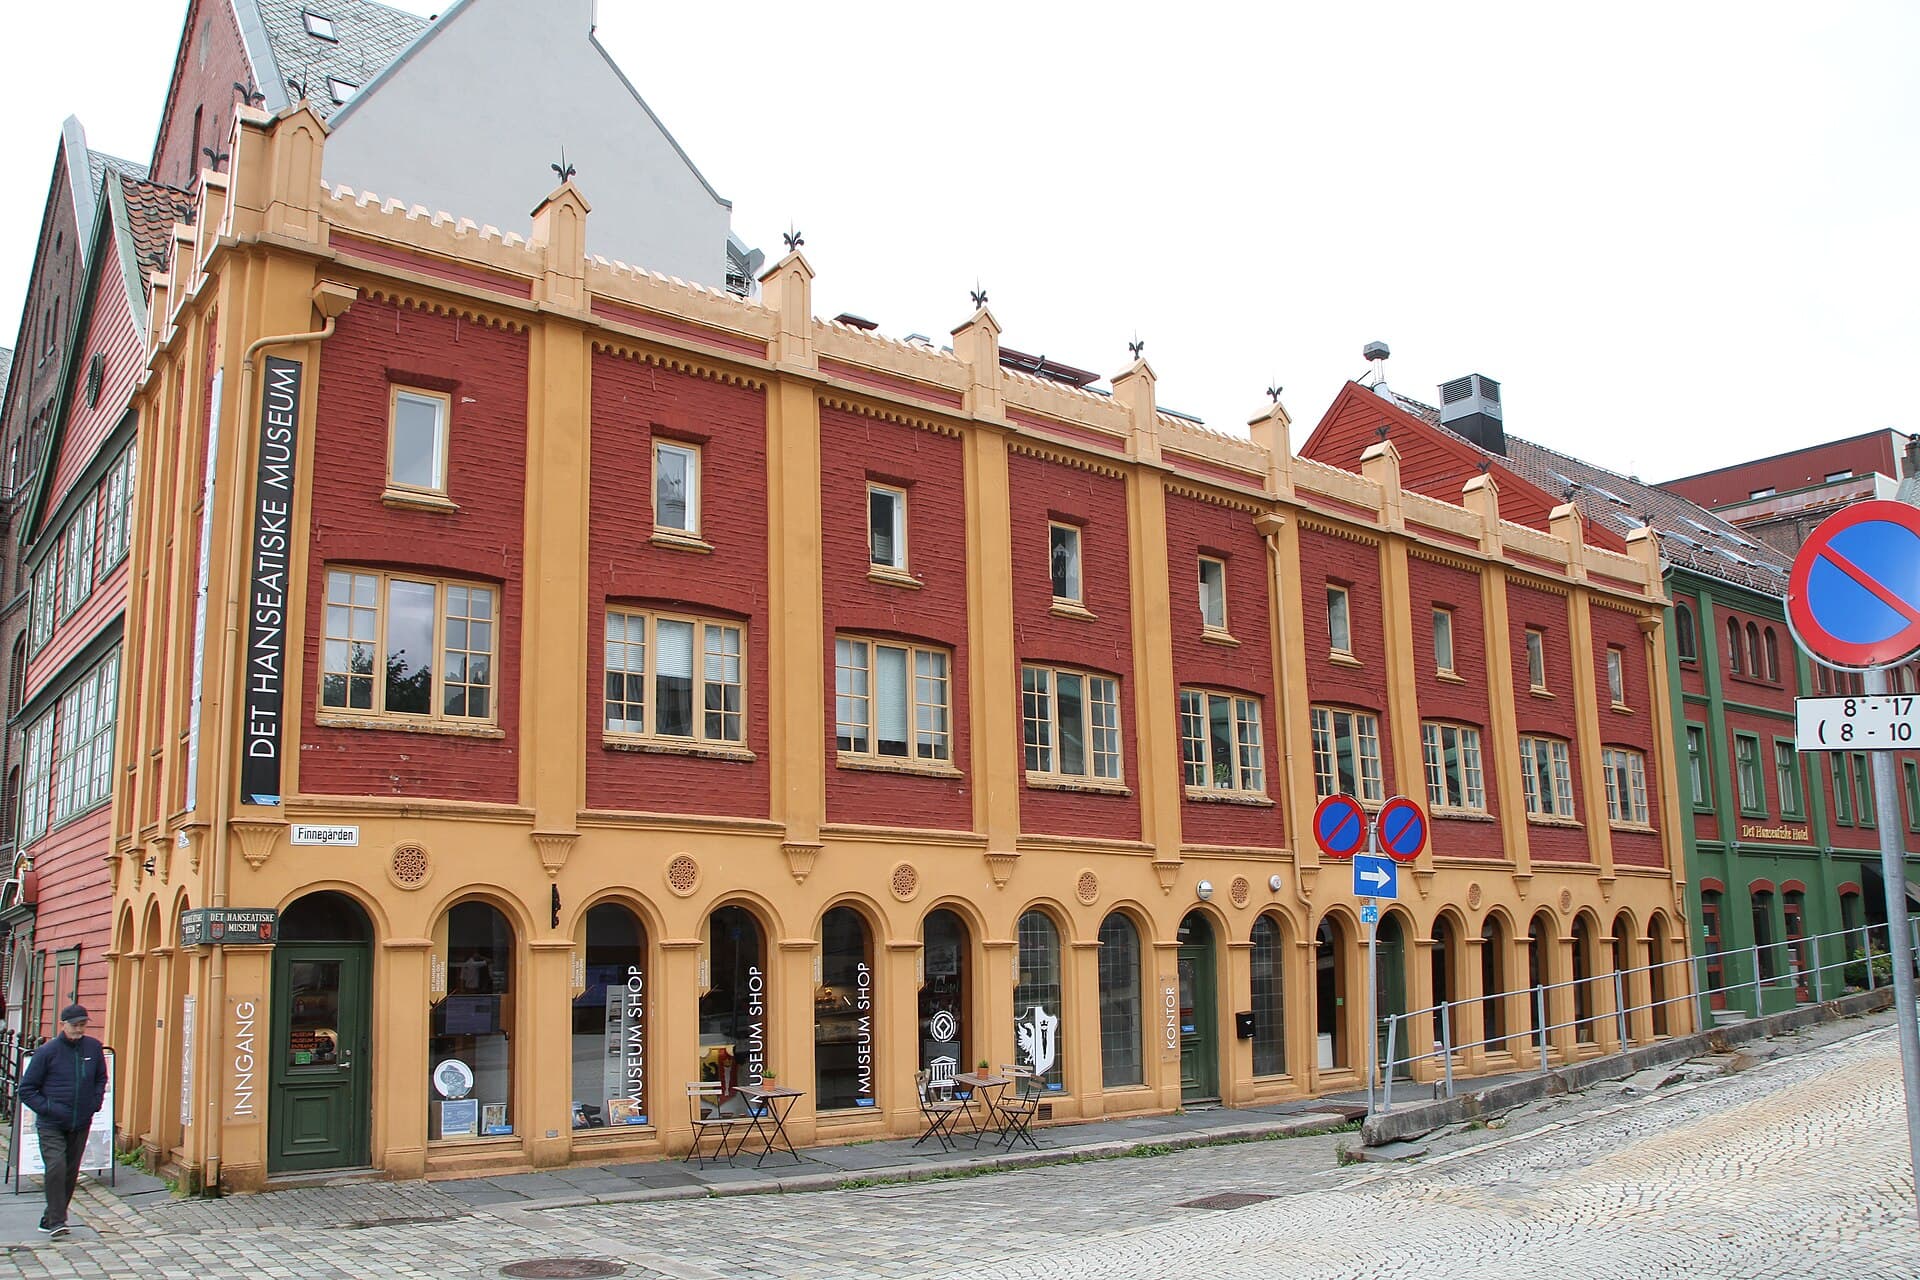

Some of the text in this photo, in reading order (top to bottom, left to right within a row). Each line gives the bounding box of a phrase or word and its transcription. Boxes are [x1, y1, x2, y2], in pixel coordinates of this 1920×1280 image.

[263, 367, 296, 490] MUSEUM
[252, 499, 287, 694] HANSEATISKE
[249, 705, 276, 758] DET
[1841, 723, 1853, 741] 8
[1889, 722, 1912, 741] 10
[1844, 699, 1857, 717] 8
[1892, 697, 1913, 716] 17
[297, 827, 354, 843] Finnegården
[1742, 824, 1809, 841] Det Hanseatiske Hotel
[210, 913, 225, 922] DET
[226, 913, 275, 922] HANSEATISKE
[228, 923, 257, 932] MUSEUM
[627, 965, 643, 1018] SHOP
[749, 966, 763, 1016] SHOP
[857, 962, 871, 1010] SHOP
[1165, 987, 1176, 1049] KONTOR
[233, 1001, 255, 1115] INNGANG
[627, 1023, 643, 1110] MUSEUM
[857, 1015, 871, 1094] MUSEUM
